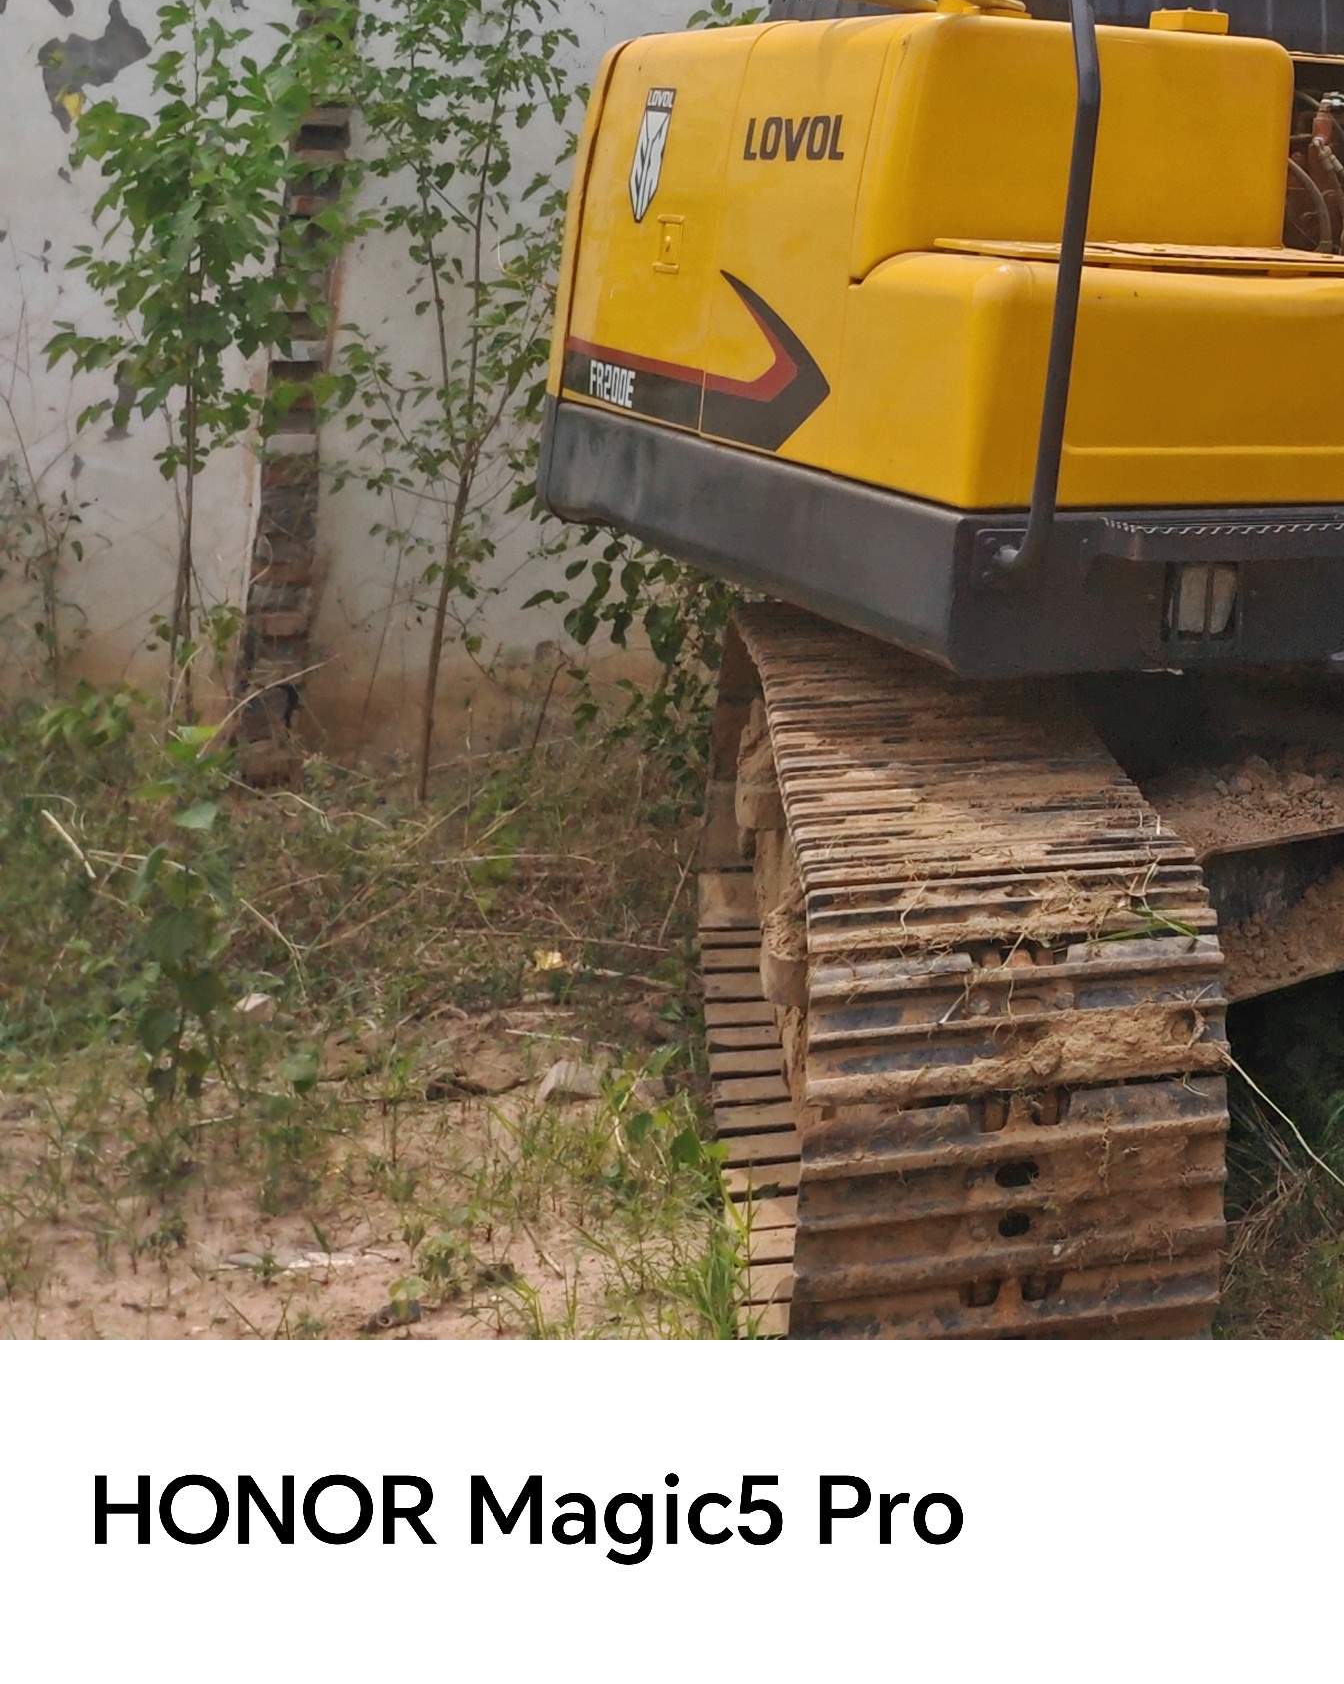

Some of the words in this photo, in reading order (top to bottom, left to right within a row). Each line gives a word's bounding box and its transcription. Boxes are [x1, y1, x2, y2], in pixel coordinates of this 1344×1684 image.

[647, 89, 674, 108] LOVOL
[743, 114, 845, 162] LOVOL
[589, 358, 636, 409] FR200E
